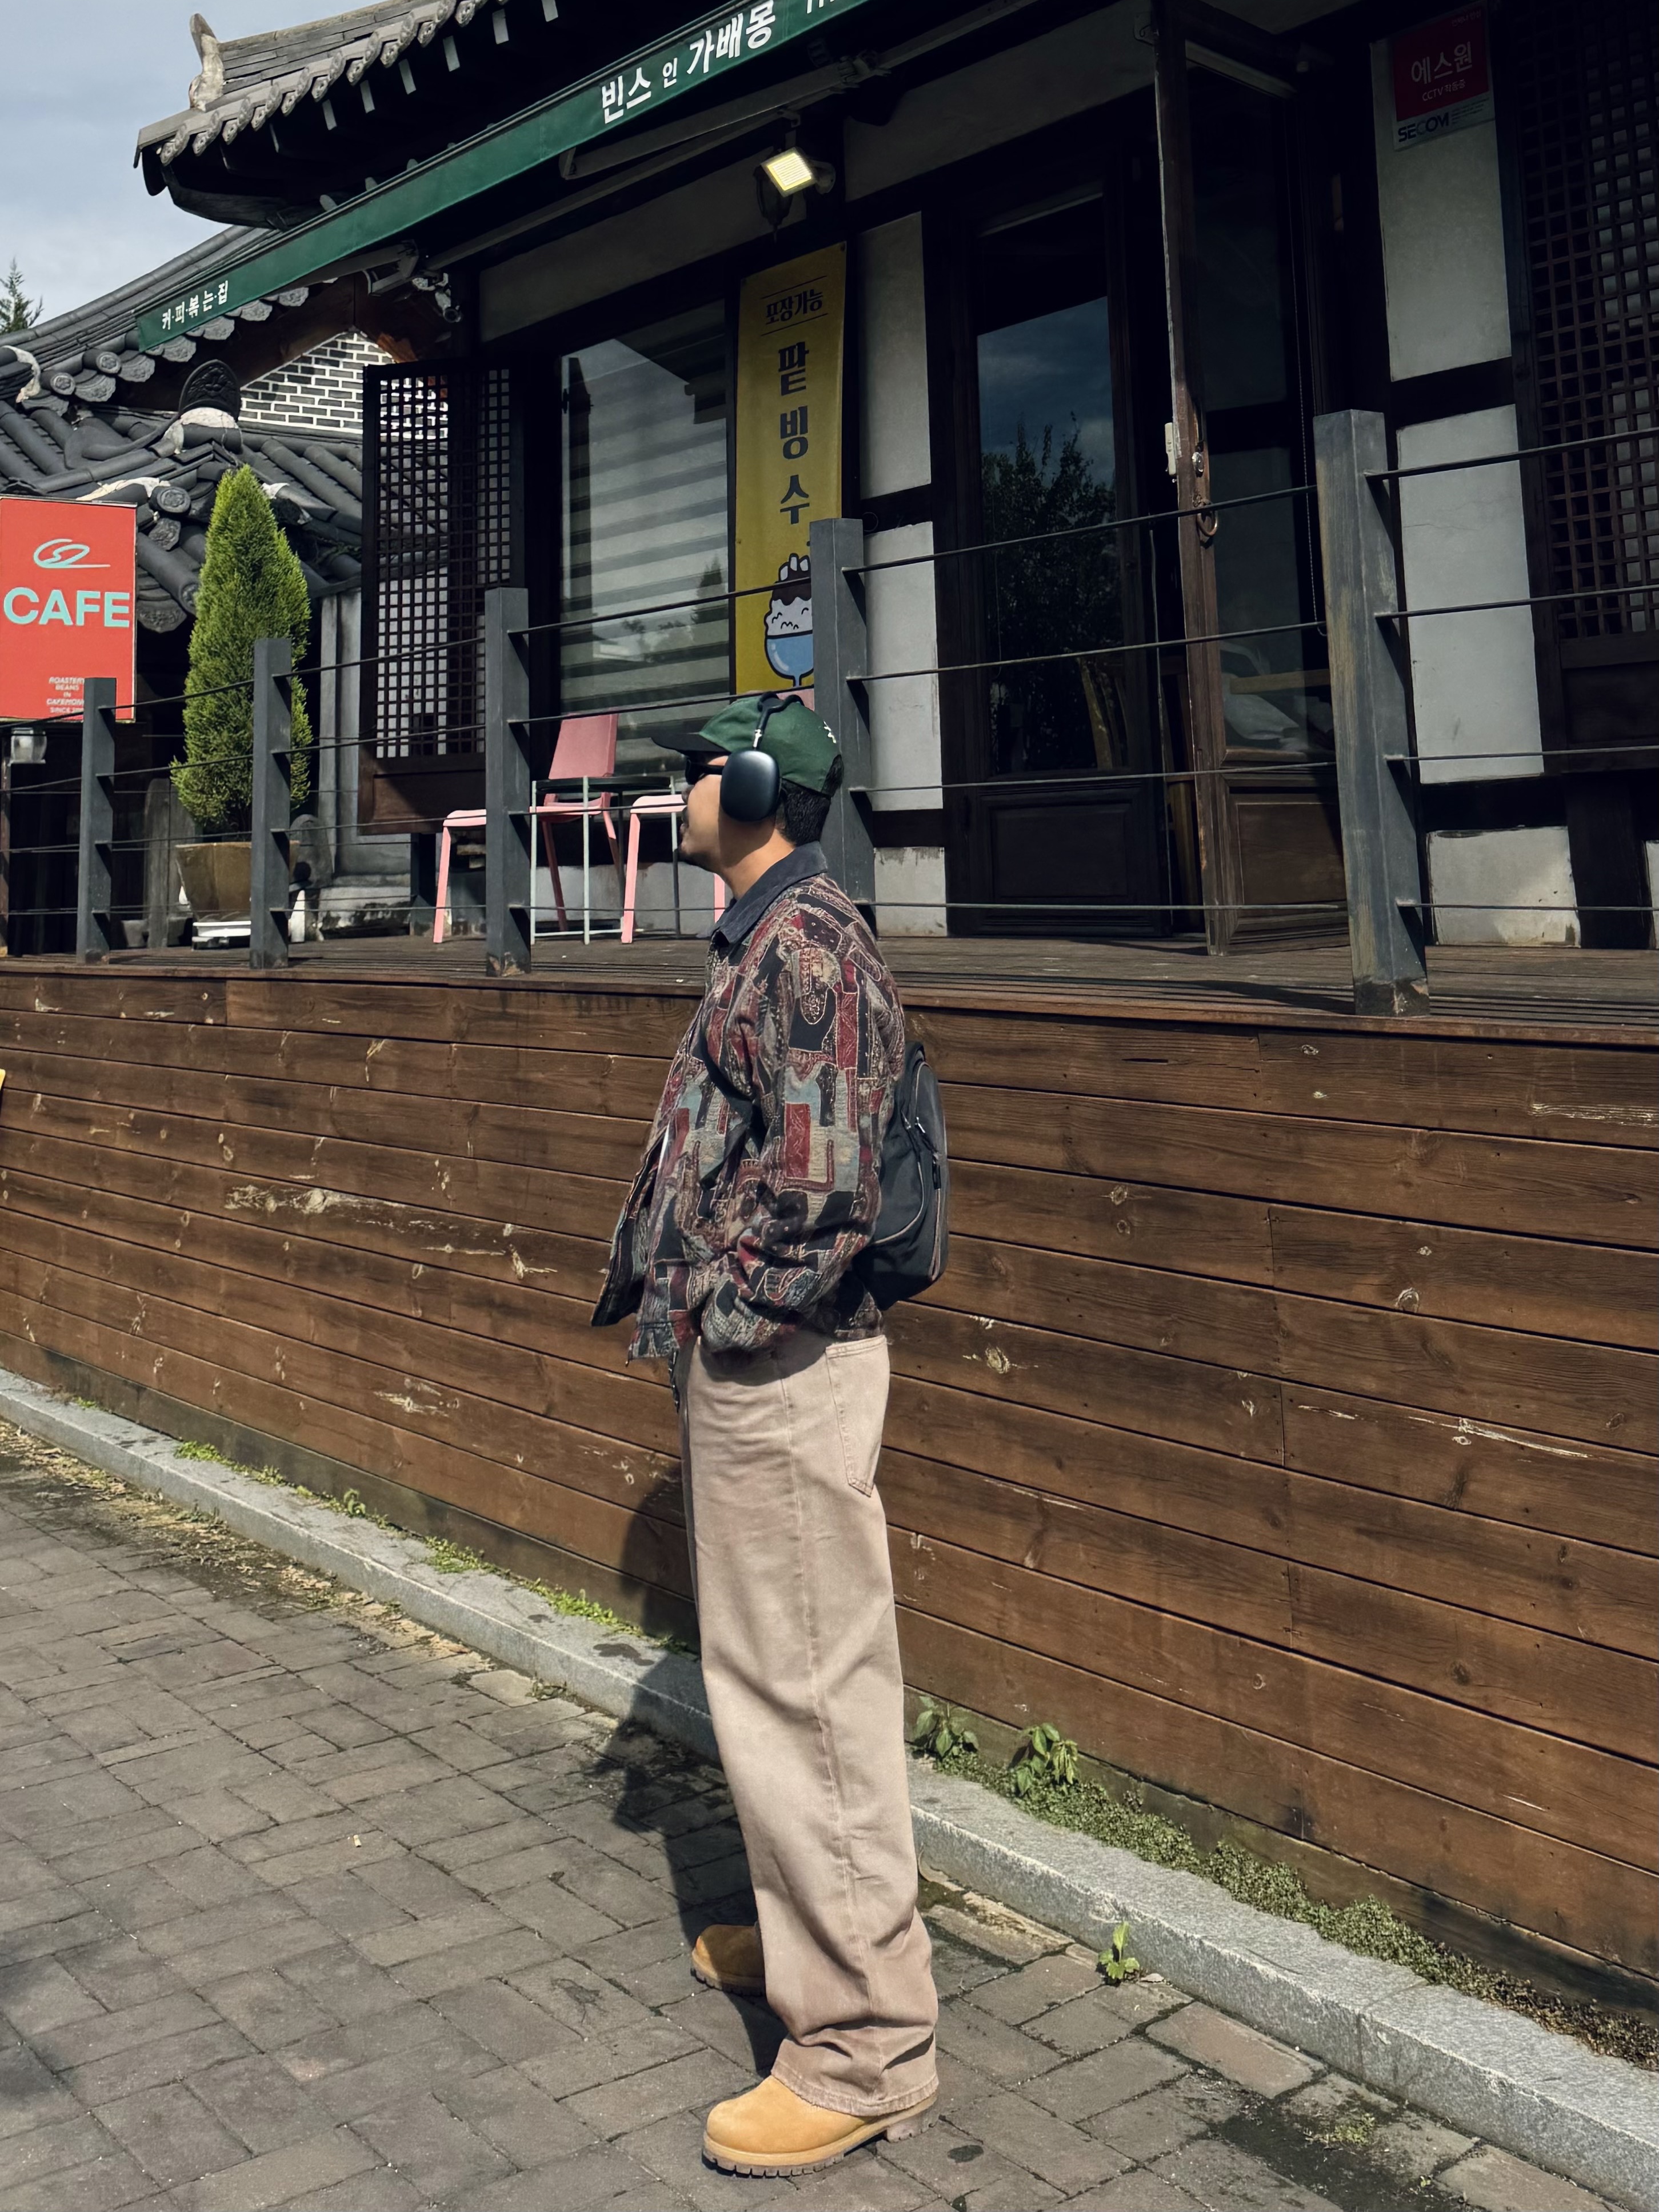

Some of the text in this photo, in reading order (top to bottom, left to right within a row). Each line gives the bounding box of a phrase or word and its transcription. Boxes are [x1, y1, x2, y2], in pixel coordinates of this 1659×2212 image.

[602, 1, 775, 124] 빈스 인 가배몽
[1411, 41, 1473, 84] 에스원
[1422, 87, 1444, 101] CCTV
[1398, 112, 1449, 142] SECOM
[765, 289, 823, 325] 포장가능
[778, 341, 810, 525] 팥빙수
[3, 587, 130, 627] CAFE
